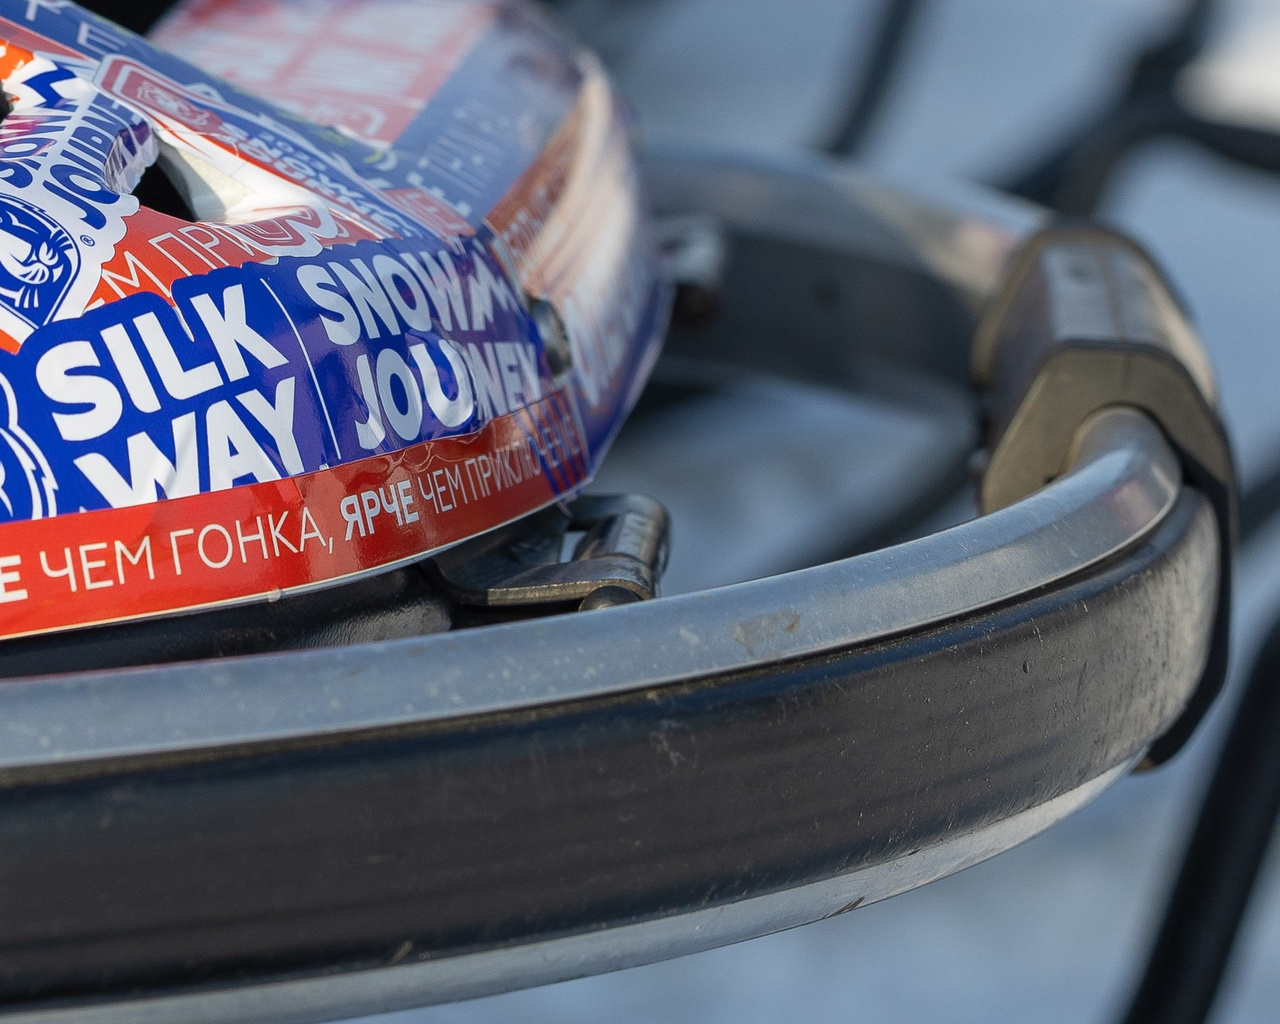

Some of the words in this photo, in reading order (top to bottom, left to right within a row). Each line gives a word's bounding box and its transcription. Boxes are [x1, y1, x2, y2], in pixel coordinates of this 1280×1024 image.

[297, 247, 470, 346] SNOW
[35, 282, 290, 442] SILK
[356, 339, 543, 450] JOUNEY
[73, 376, 305, 509] WAY
[39, 534, 156, 593] ЧЕМ
[170, 506, 335, 575] ГОНКА,
[339, 479, 420, 542] ЯРЧЕ
[417, 463, 469, 515] ЧЕМ
